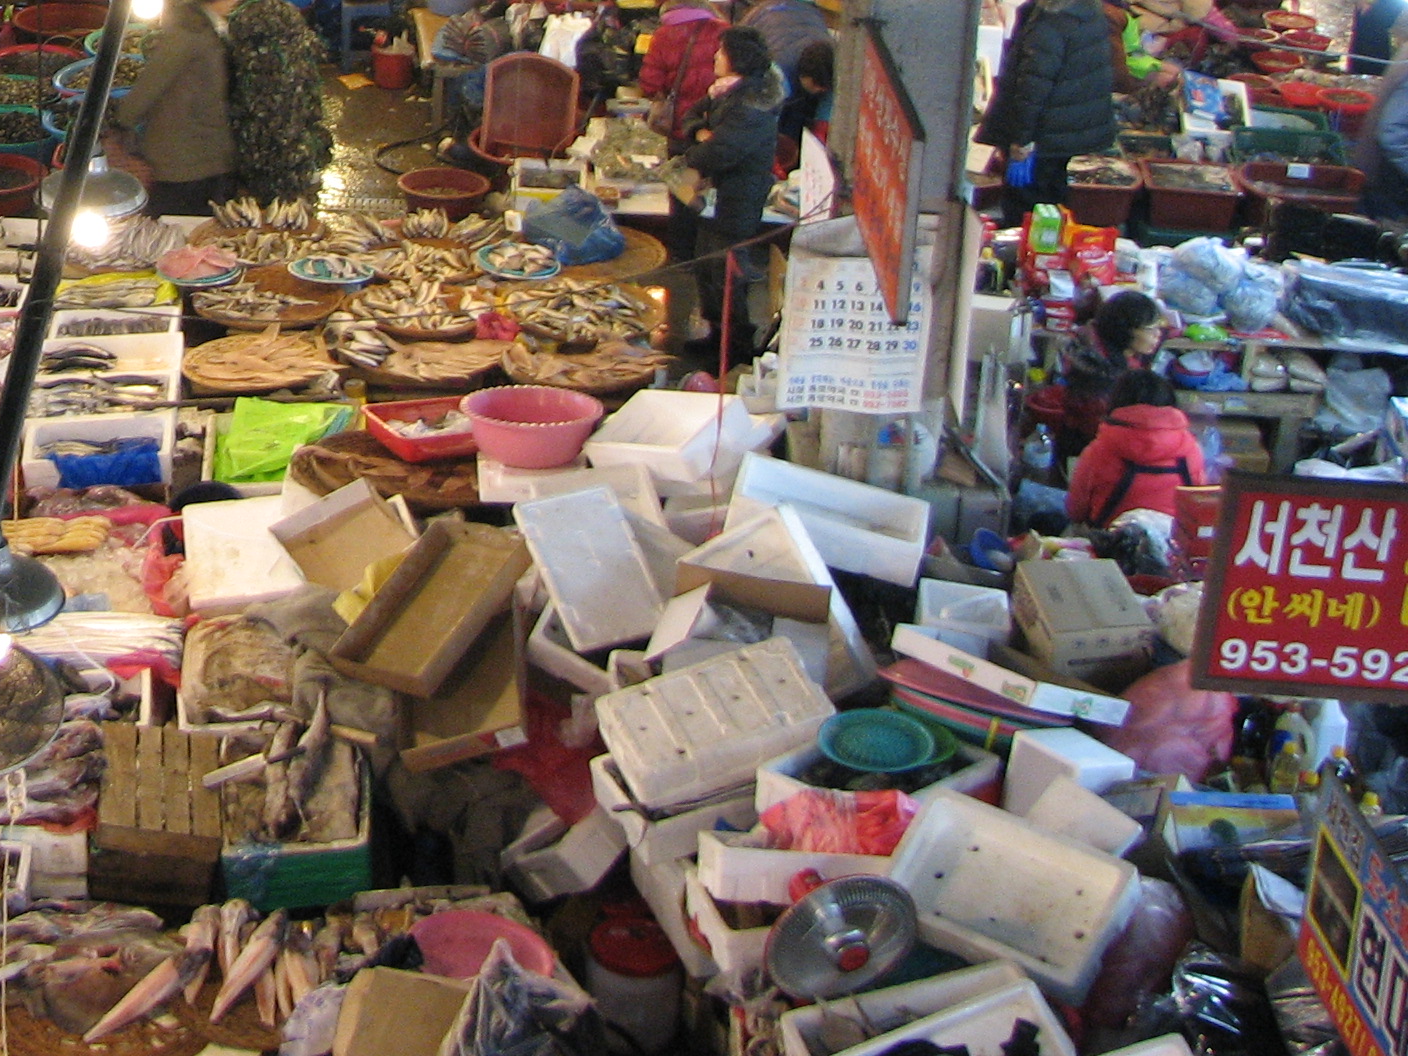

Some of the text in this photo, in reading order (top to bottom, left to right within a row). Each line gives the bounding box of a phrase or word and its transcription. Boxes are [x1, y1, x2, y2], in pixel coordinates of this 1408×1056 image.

[814, 299, 826, 310] 11
[832, 299, 845, 310] 12
[850, 300, 865, 311] 13
[811, 319, 825, 329] 18
[830, 318, 844, 329] 19
[848, 319, 864, 330] 20
[868, 321, 883, 331] 21
[809, 337, 824, 348] 25
[828, 337, 842, 348] 26
[847, 338, 861, 349] 27
[866, 340, 881, 351] 28
[902, 340, 917, 351] 30
[1233, 499, 1398, 582] 서천산
